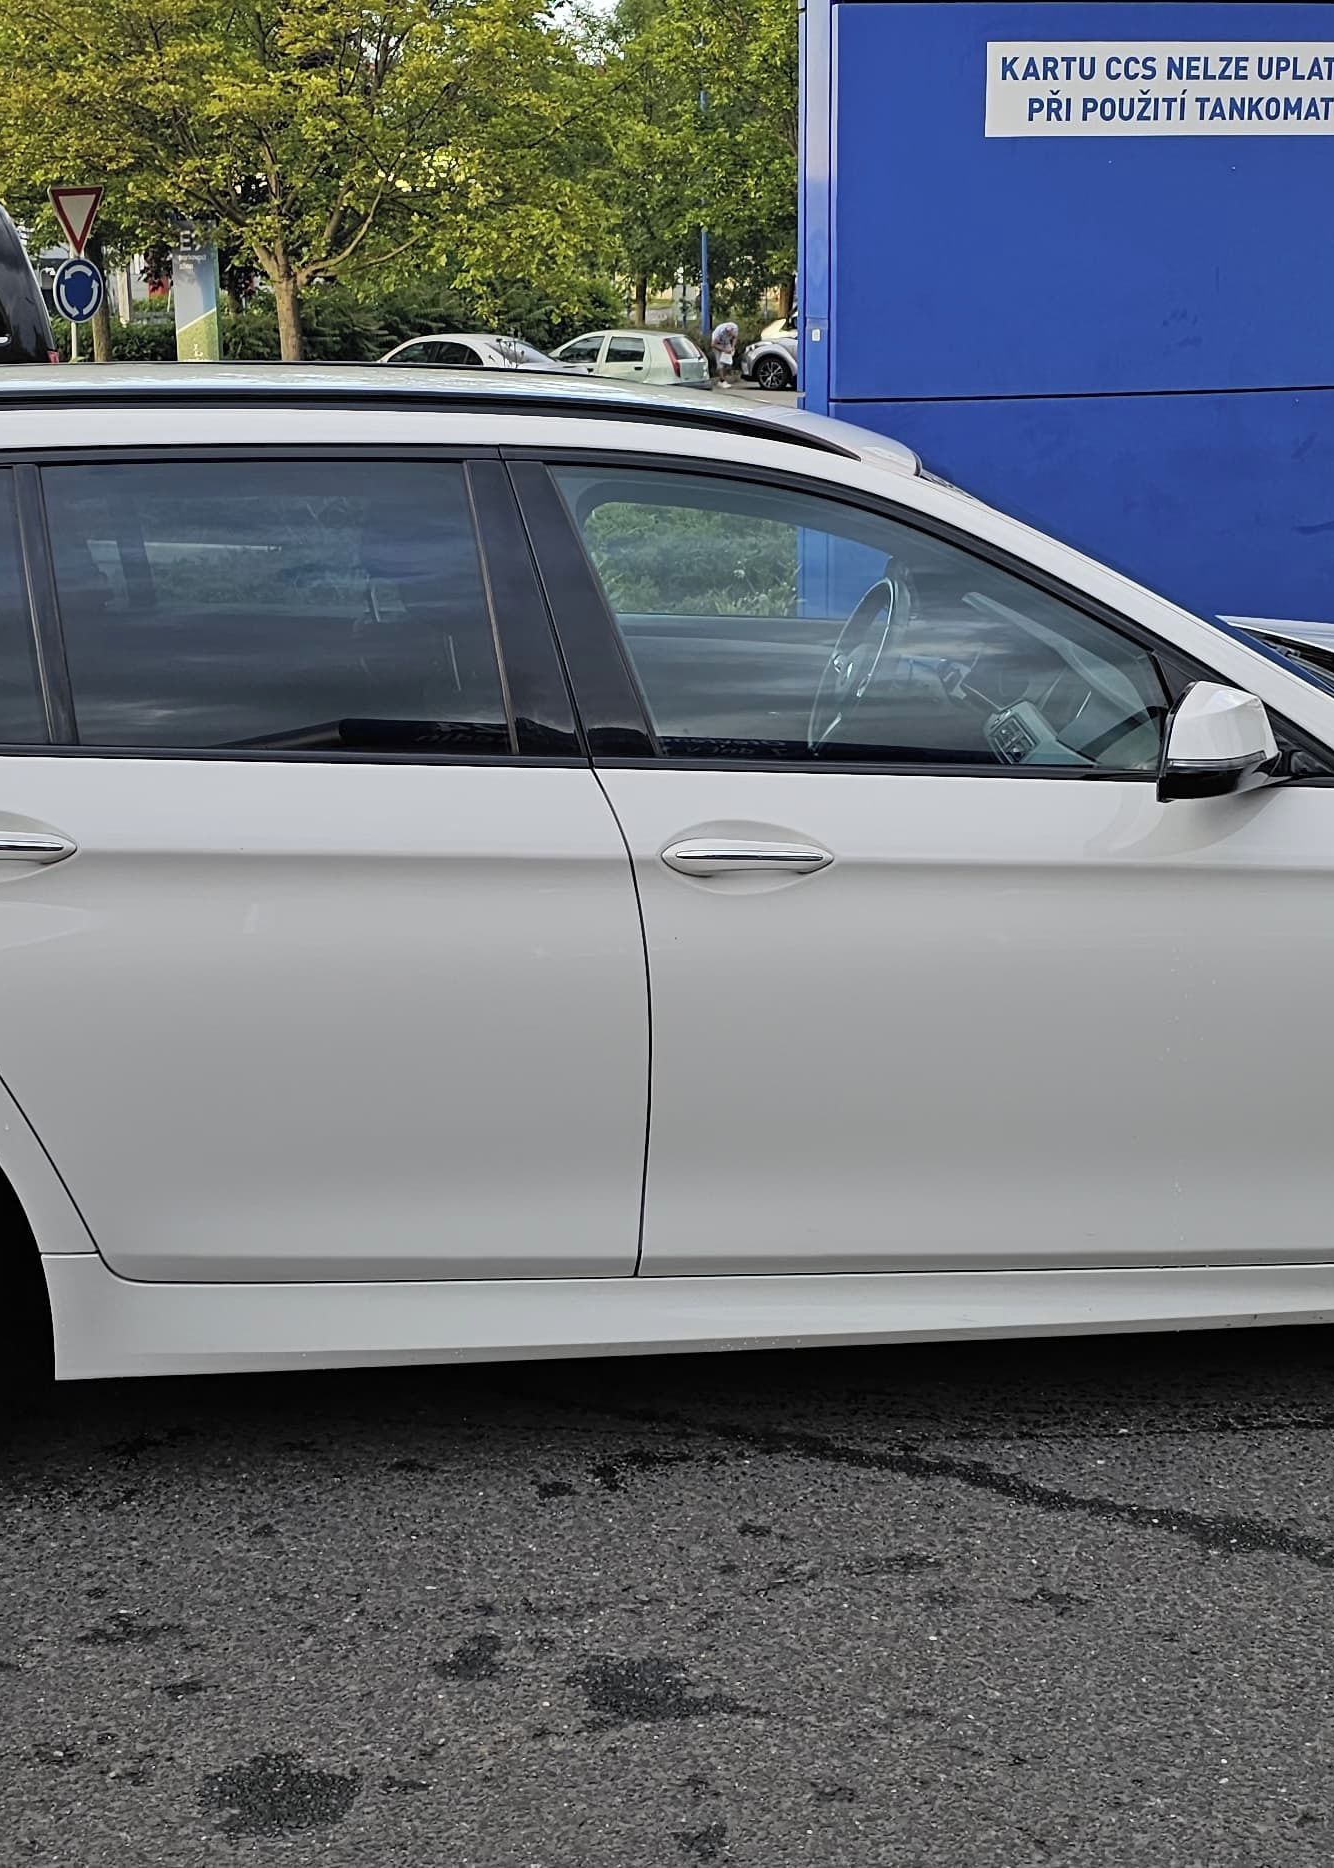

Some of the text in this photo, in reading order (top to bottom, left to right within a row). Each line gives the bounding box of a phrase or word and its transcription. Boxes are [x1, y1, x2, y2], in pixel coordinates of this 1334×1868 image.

[1001, 56, 1095, 81] KARTU
[1105, 56, 1157, 81] CCS
[1167, 56, 1249, 81] NELZE
[1028, 89, 1071, 121] PŘI
[1082, 88, 1188, 121] POUŽITÍ
